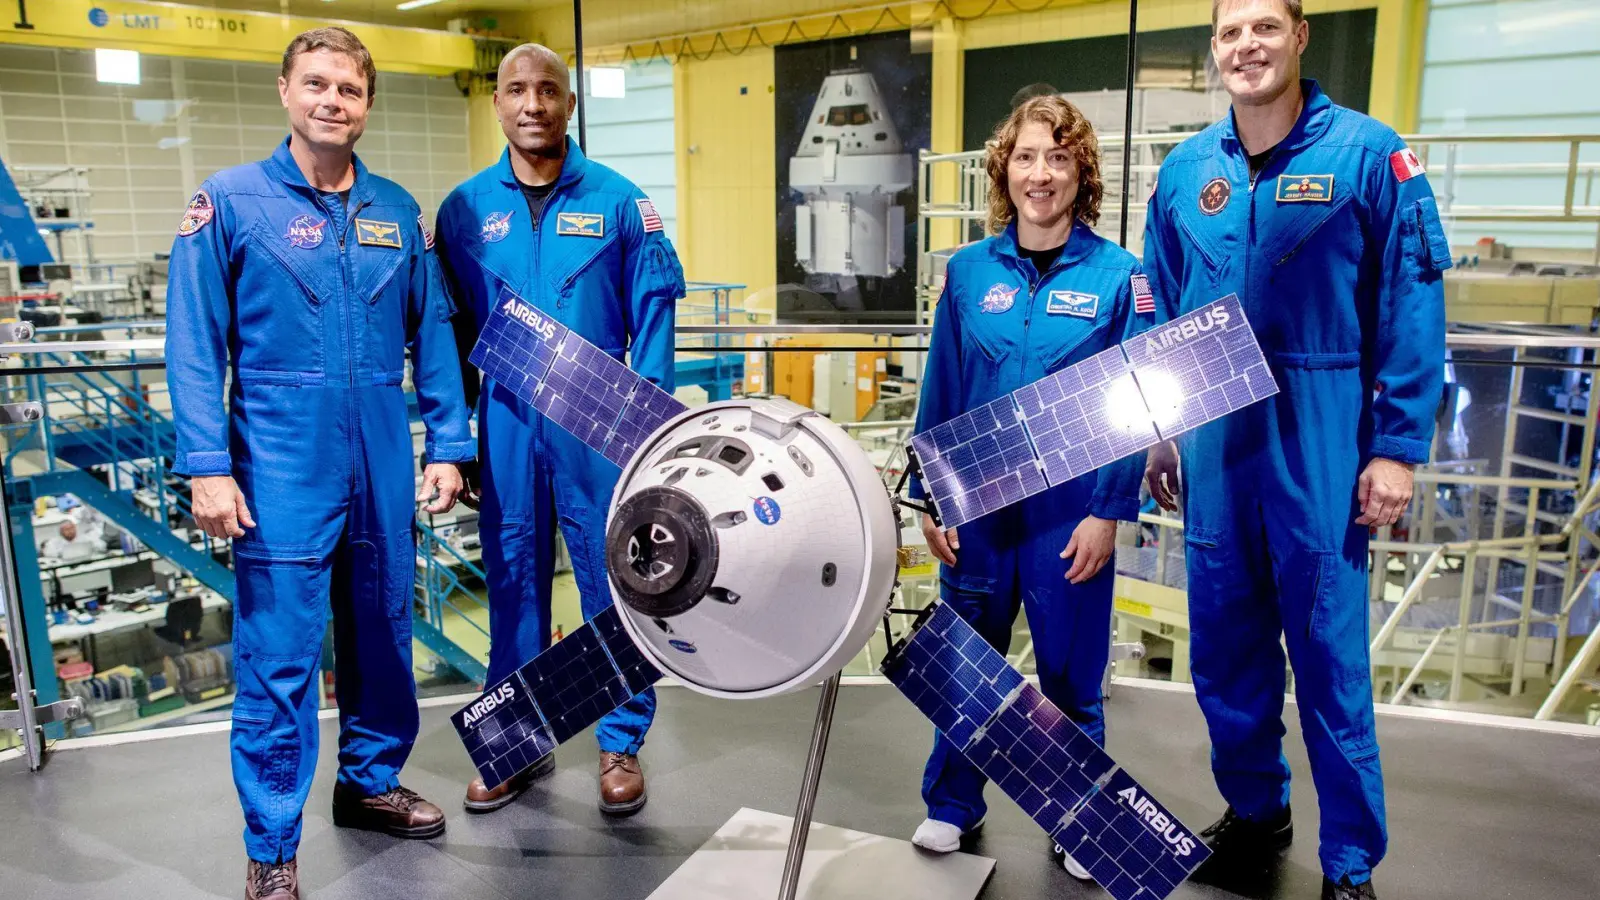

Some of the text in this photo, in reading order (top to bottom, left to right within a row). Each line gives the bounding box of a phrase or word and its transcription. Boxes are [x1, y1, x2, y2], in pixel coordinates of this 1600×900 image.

[290, 226, 323, 238] NASA
[503, 298, 556, 339] AIRBUS
[983, 294, 1014, 306] NASA
[1145, 306, 1231, 357] AIRBUS
[463, 682, 515, 728] AIRBUS
[1117, 786, 1197, 857] AIRBUS
